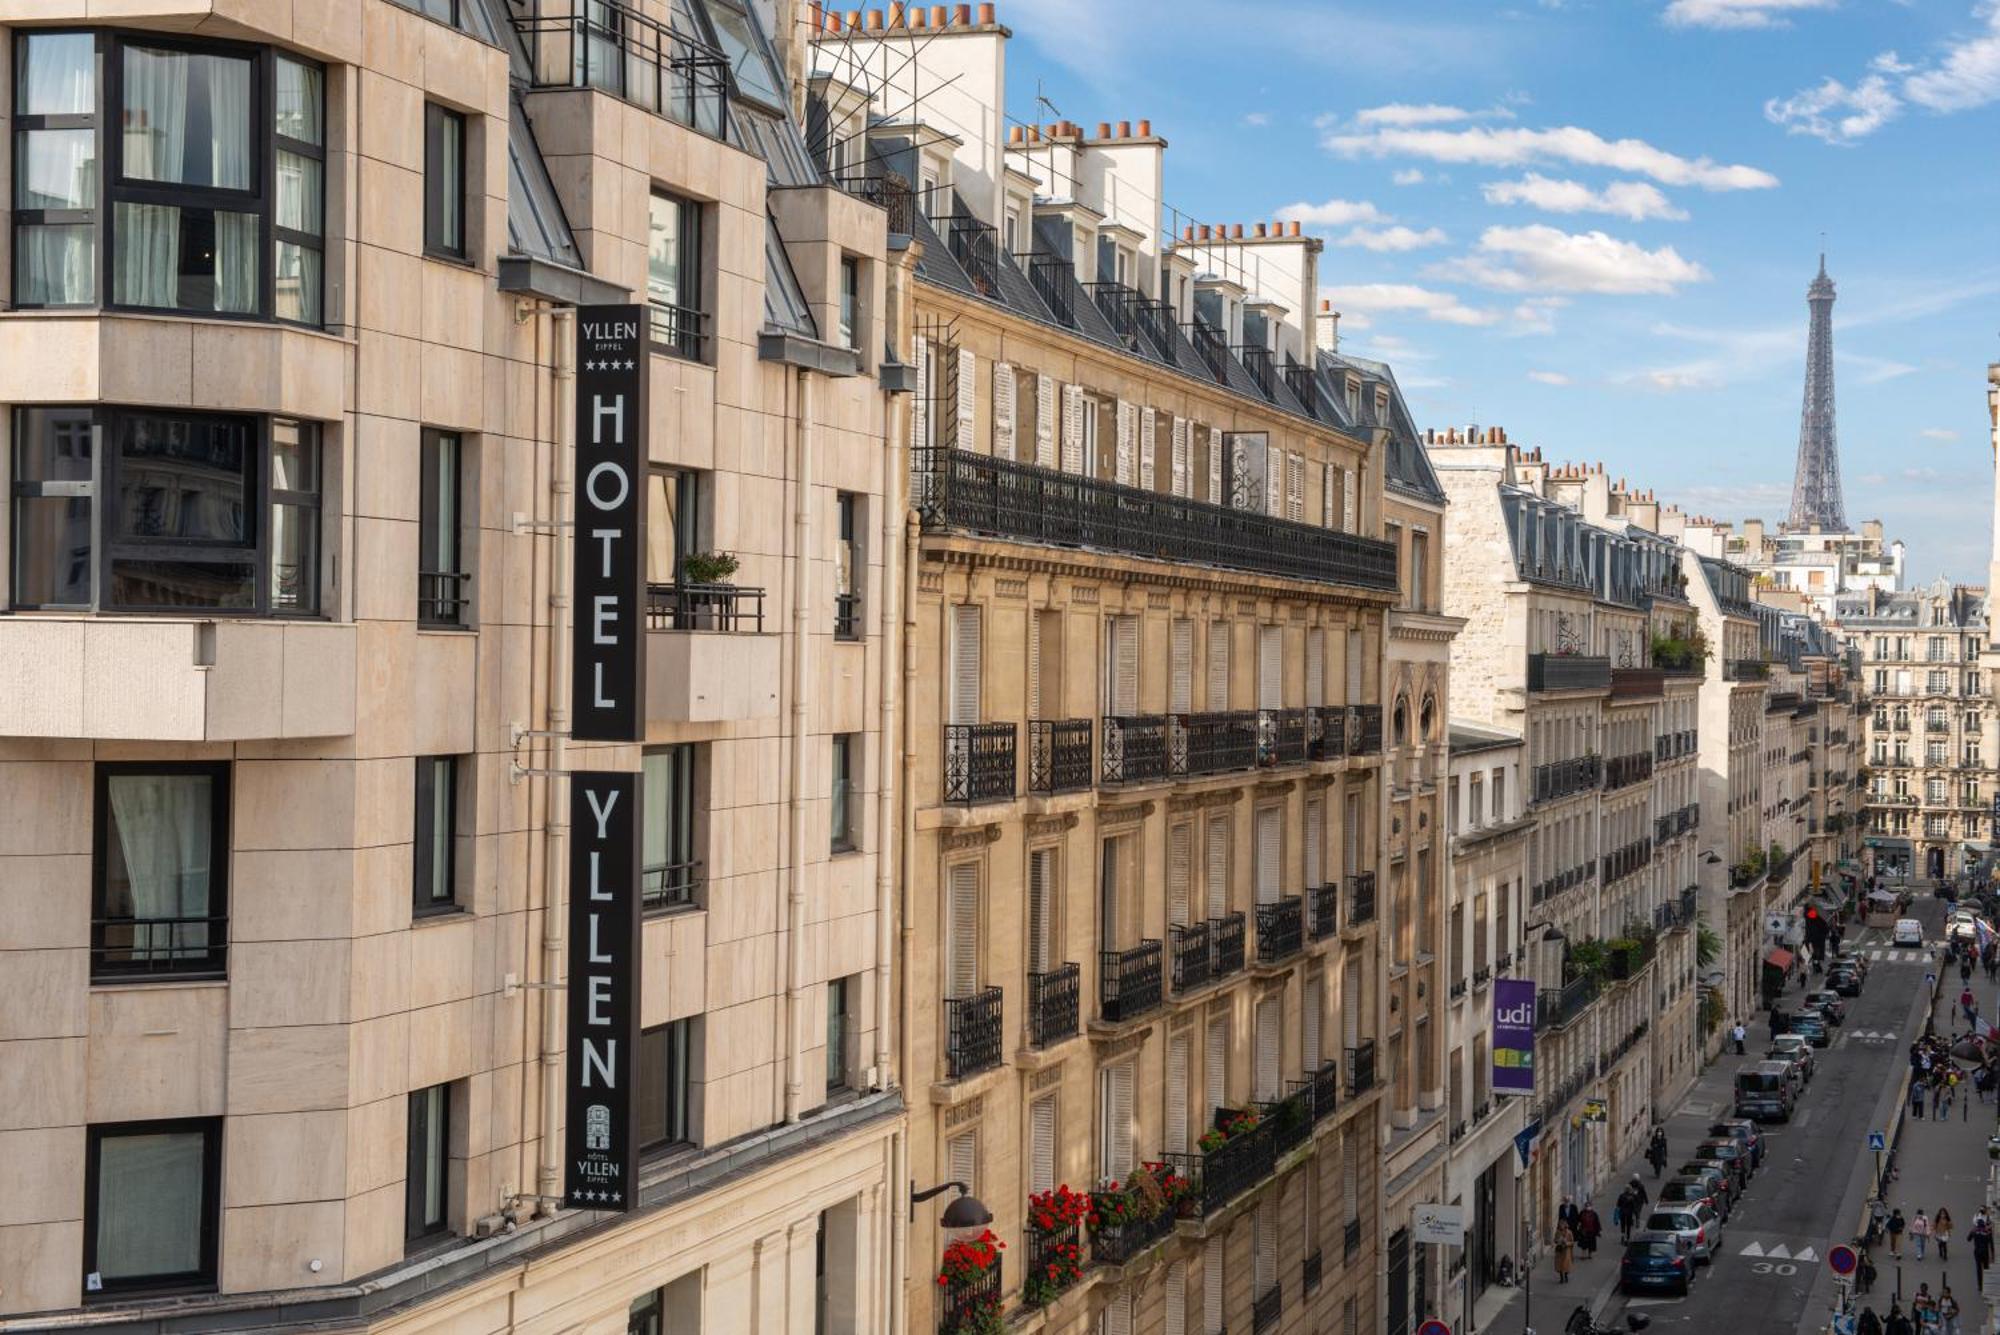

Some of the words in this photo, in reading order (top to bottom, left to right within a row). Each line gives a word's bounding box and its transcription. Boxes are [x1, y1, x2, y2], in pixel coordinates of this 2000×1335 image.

[583, 322, 636, 339] YLLEN
[586, 395, 629, 708] HOTEL
[582, 789, 619, 1089] YLLEN
[1497, 1002, 1531, 1024] udi
[577, 1161, 619, 1176] YLLEN
[1751, 1262, 1797, 1276] 30
